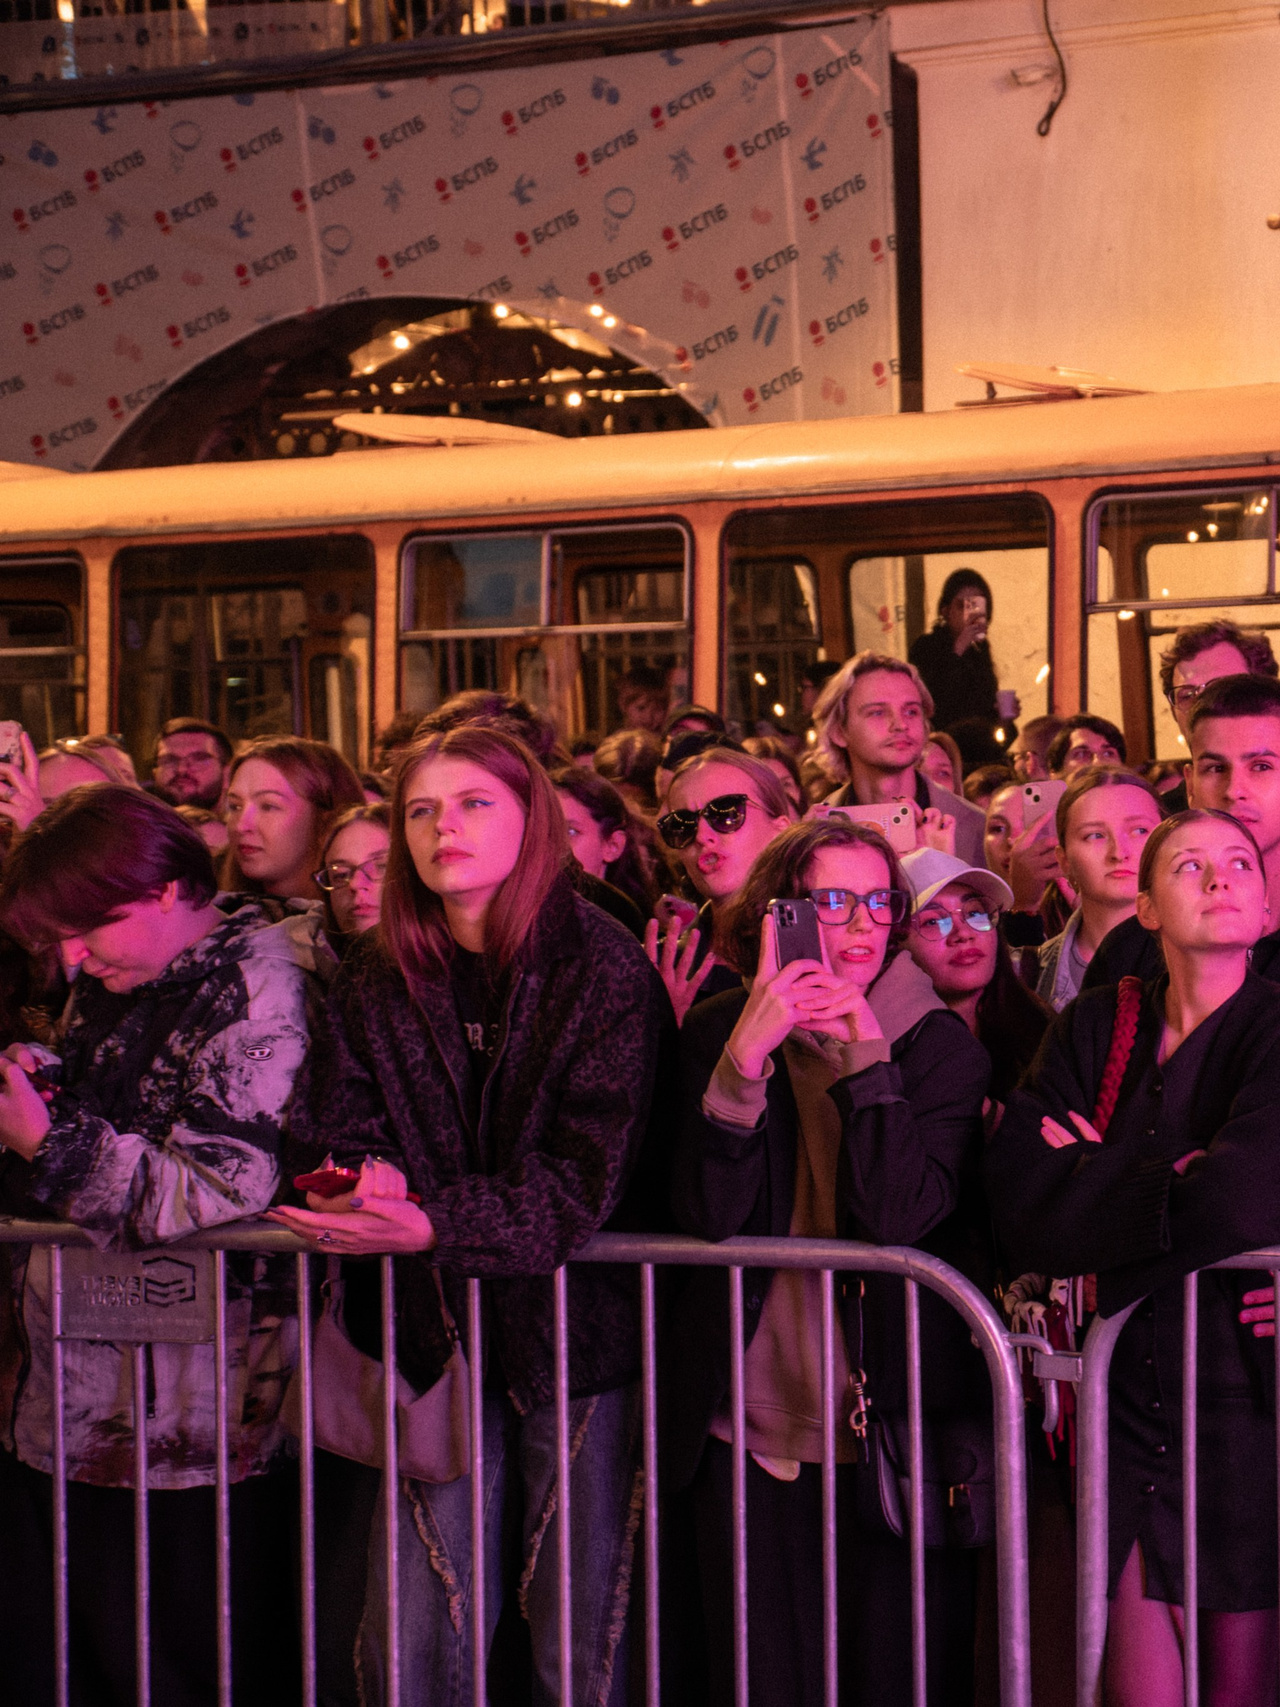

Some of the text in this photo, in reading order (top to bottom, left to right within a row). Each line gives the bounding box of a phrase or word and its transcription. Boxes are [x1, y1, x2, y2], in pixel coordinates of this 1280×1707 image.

[814, 49, 862, 85] БСПБ
[519, 89, 566, 124] БСПБ
[668, 82, 716, 117] БСПБ
[592, 129, 638, 165] БСПБ
[741, 121, 790, 158] БСПБ
[452, 157, 498, 191] БСПБ
[819, 174, 866, 211] БСПБ
[532, 209, 579, 246] БСПБ
[679, 204, 728, 240] БСПБ
[604, 250, 652, 285] БСПБ
[752, 244, 799, 280] БСПБ
[467, 275, 512, 299] СПБ
[825, 298, 869, 333] БСПБ
[693, 326, 739, 362] БСПБ
[759, 367, 804, 401] БСПБ
